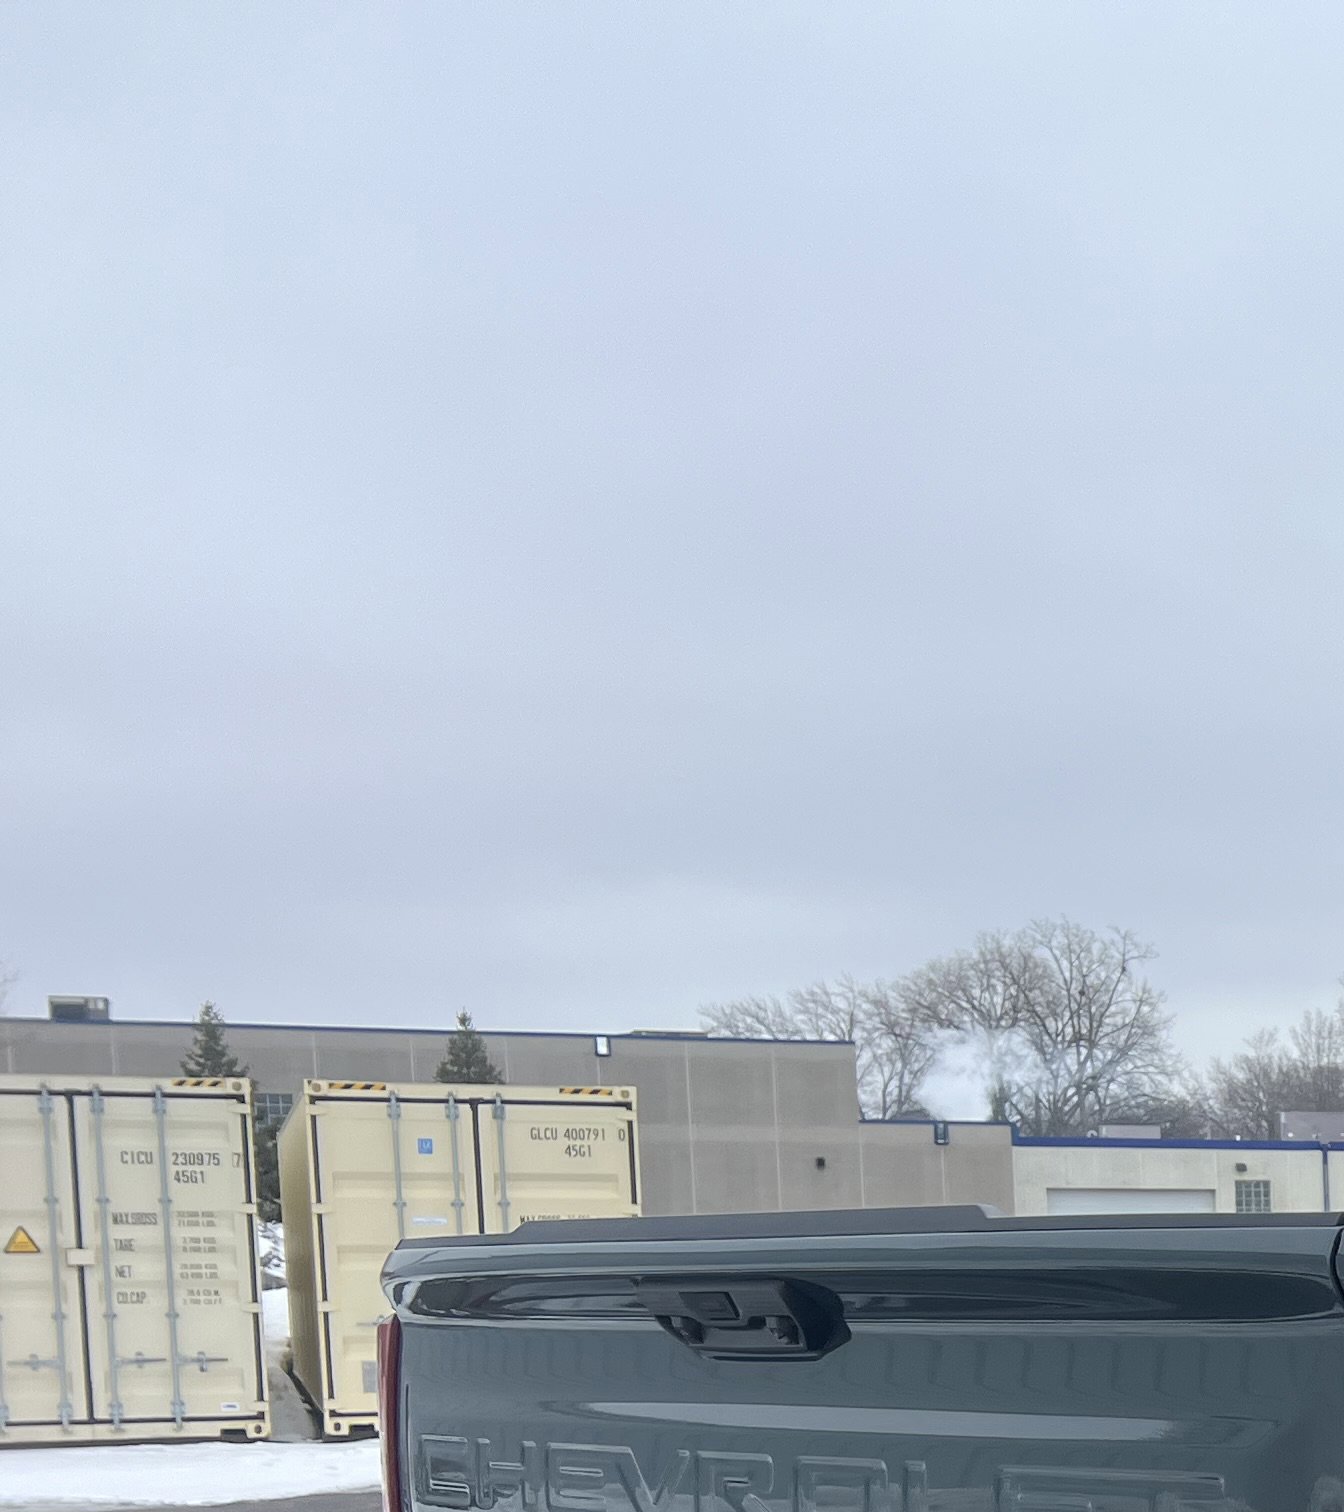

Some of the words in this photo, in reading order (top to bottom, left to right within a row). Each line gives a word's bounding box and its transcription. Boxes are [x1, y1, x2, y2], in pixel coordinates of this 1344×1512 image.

[530, 1126, 558, 1141] GLCU
[563, 1127, 606, 1142] 400791
[564, 1143, 592, 1158] 45G1
[171, 1151, 221, 1167] 230975
[173, 1169, 205, 1184] 45G1
